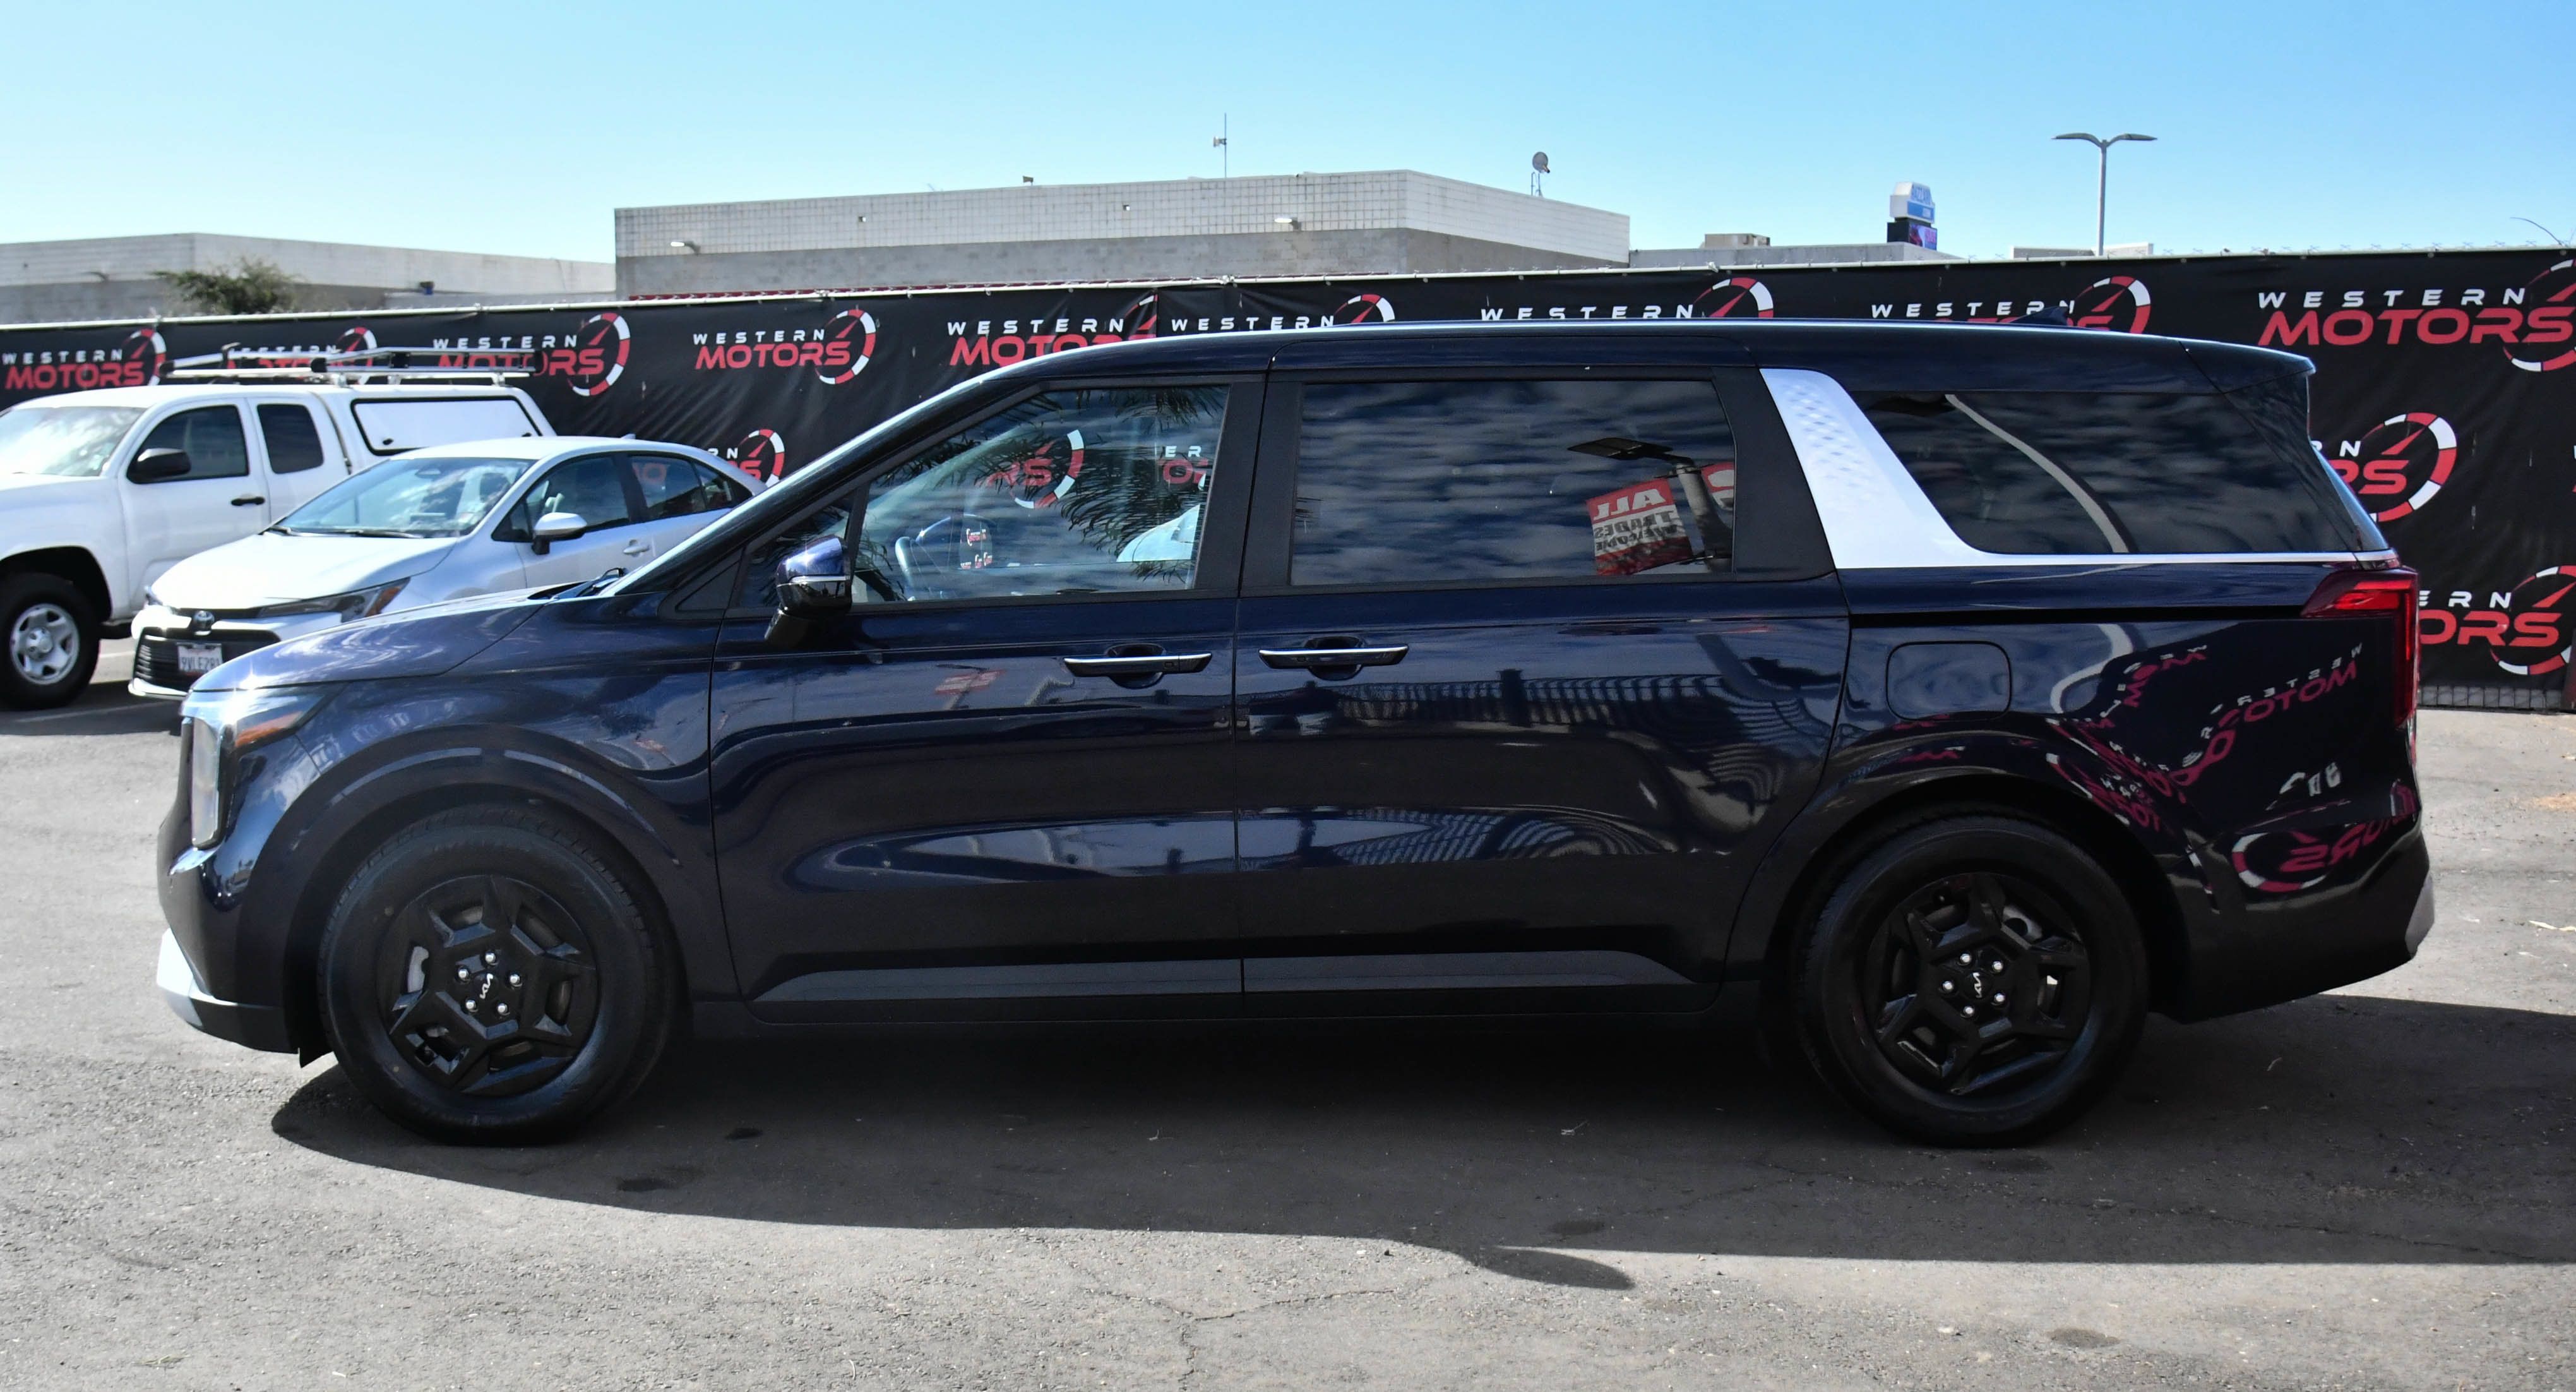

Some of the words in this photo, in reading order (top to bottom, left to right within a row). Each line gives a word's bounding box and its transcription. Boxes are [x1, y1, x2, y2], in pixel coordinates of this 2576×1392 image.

[2258, 288, 2525, 308] WESTERN
[1481, 304, 1694, 321] WESTERN
[1871, 300, 2075, 318] WESTERN
[947, 318, 1124, 336] WESTERN
[1171, 316, 1335, 331] WESTERN
[2258, 306, 2576, 346] MOTORS
[432, 334, 578, 350] WESTERN
[693, 328, 825, 345] WESTERN
[1, 349, 123, 365] WESTERN
[695, 340, 851, 369] MOTORS
[4, 361, 145, 390] MOTORS
